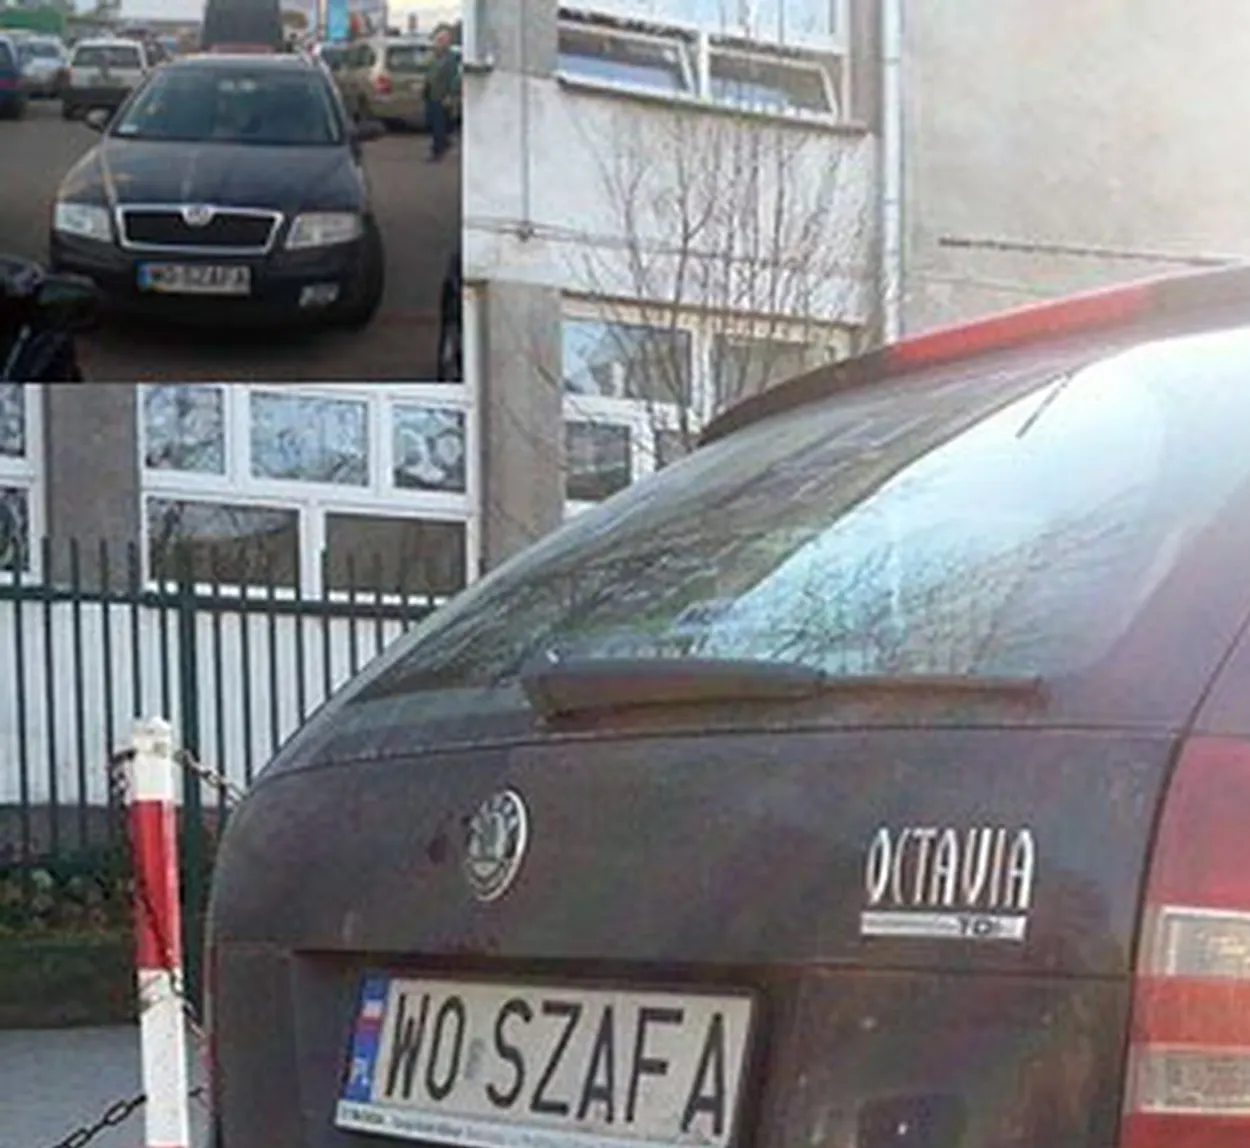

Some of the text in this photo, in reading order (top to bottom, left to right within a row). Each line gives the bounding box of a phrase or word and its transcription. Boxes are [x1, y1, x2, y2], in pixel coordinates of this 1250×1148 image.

[865, 827, 1035, 909] OCTAVIA
[385, 993, 466, 1101] WO
[485, 996, 727, 1136] SZAFA
